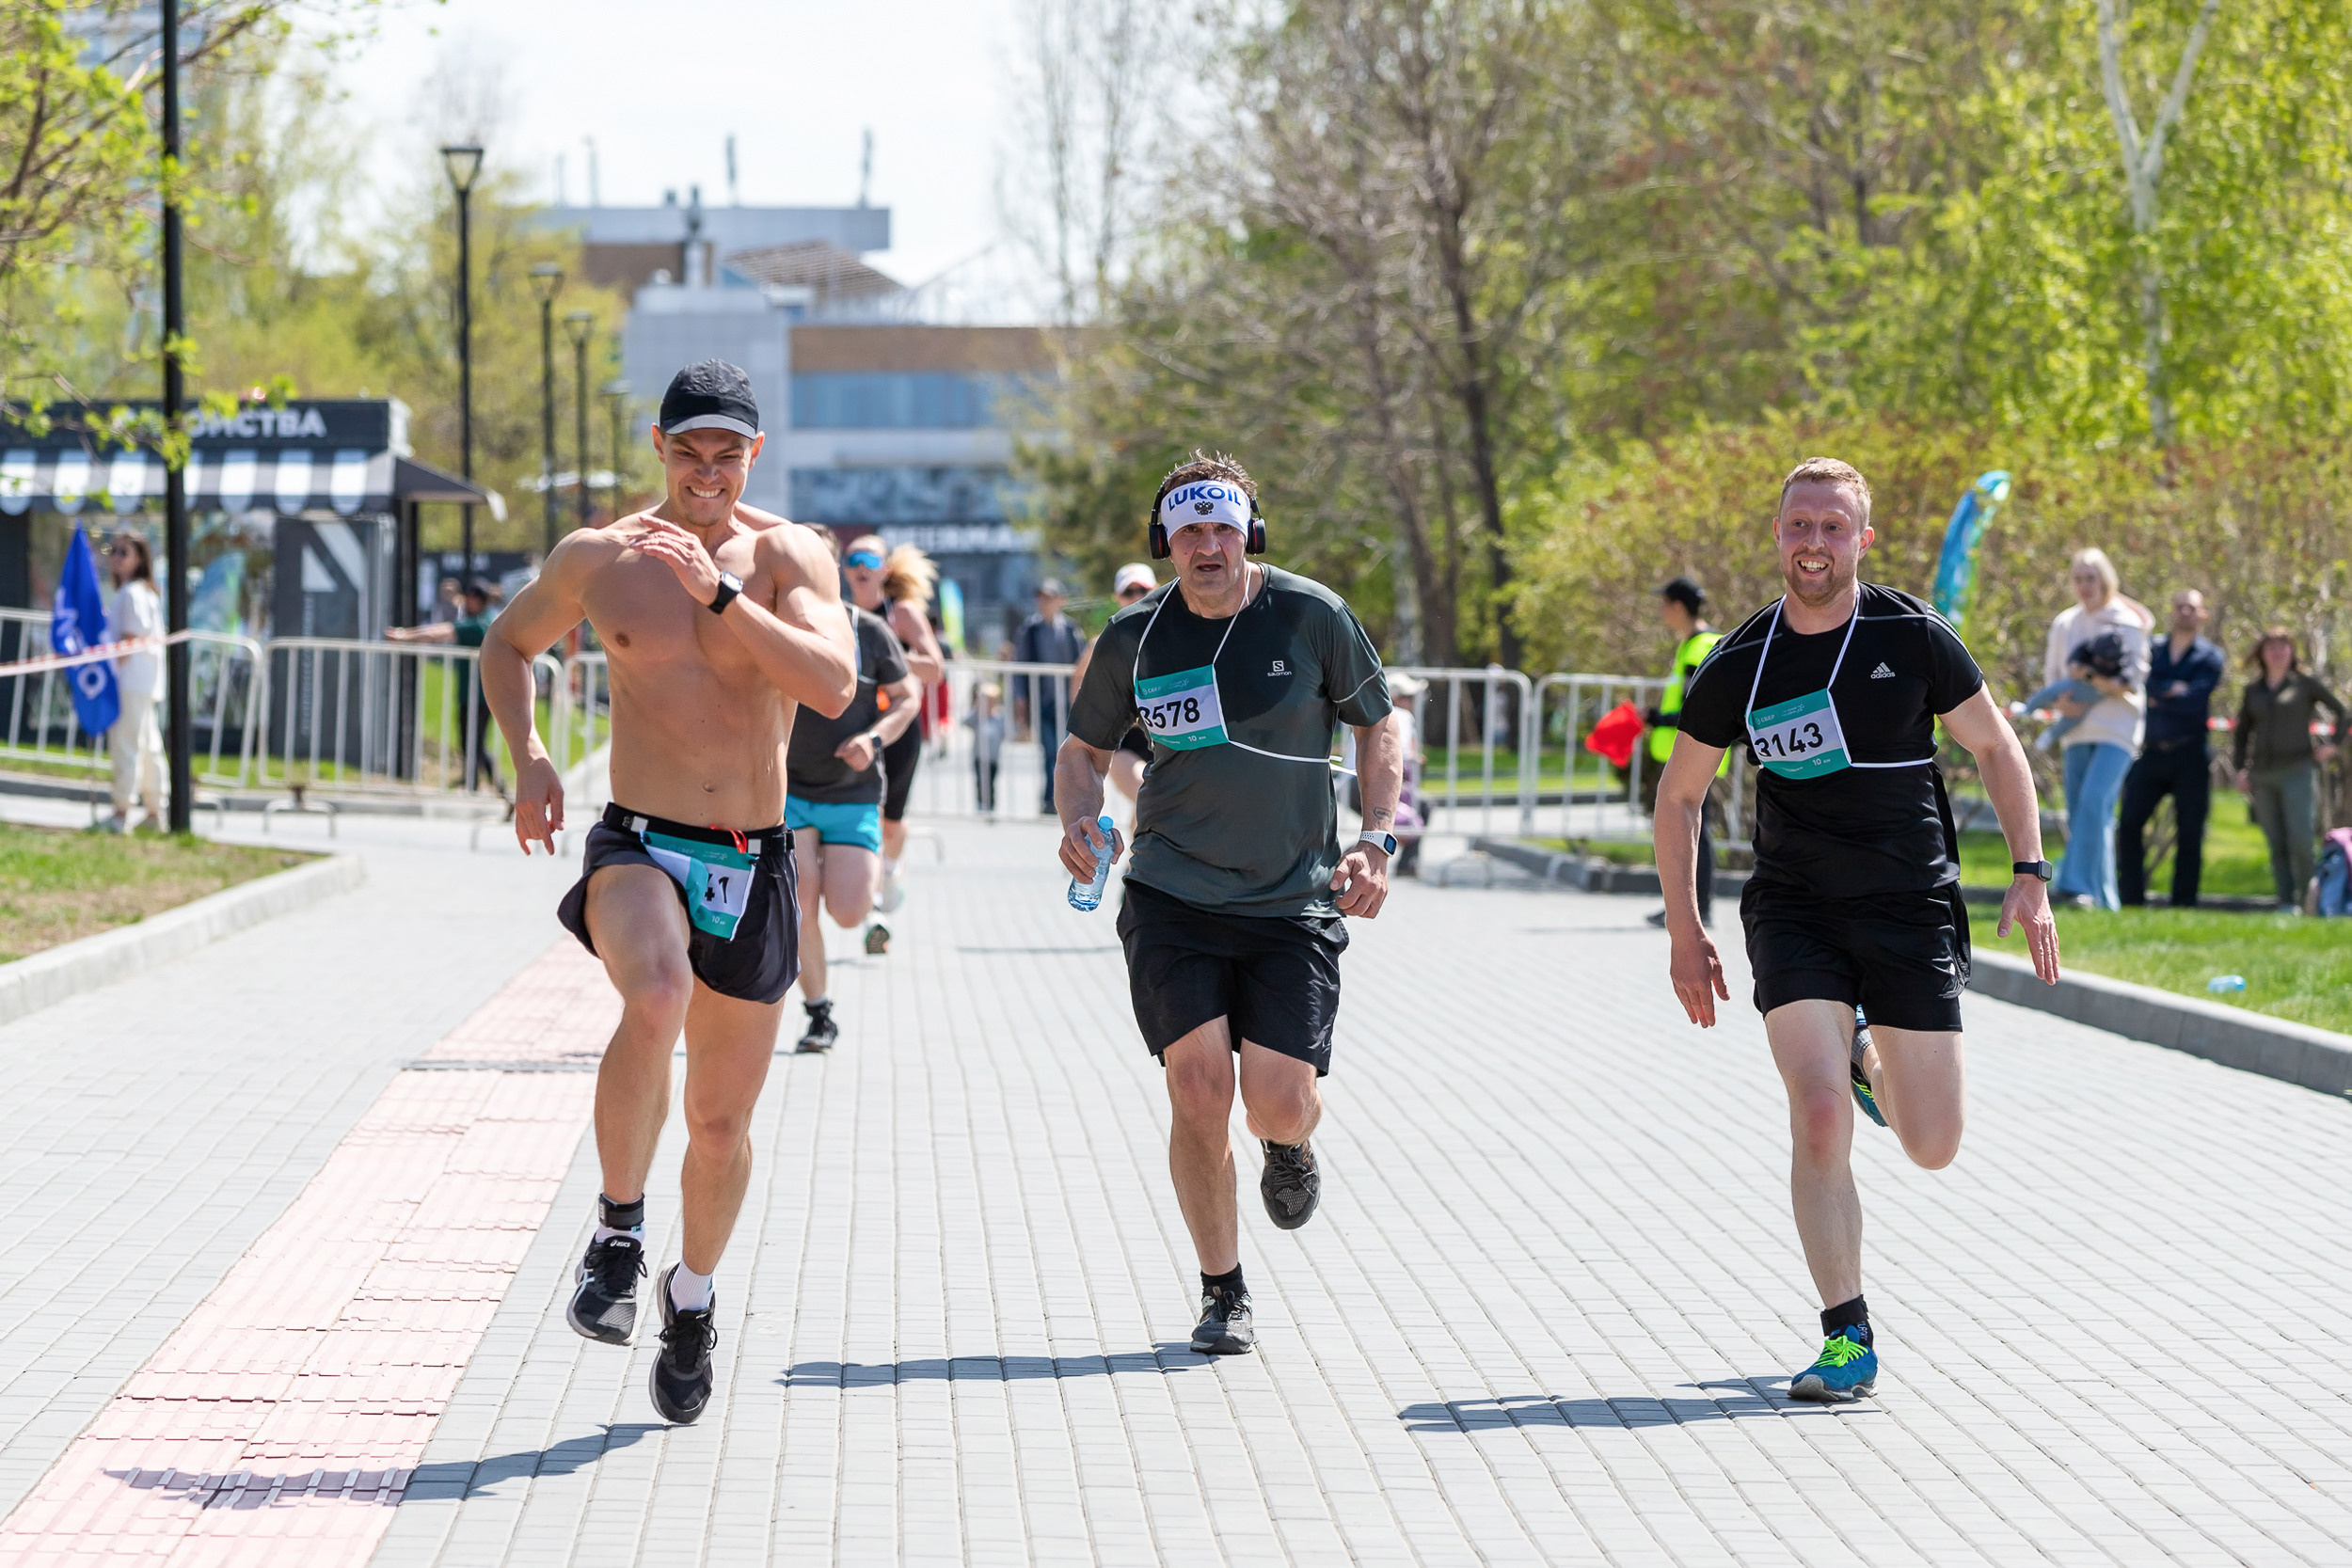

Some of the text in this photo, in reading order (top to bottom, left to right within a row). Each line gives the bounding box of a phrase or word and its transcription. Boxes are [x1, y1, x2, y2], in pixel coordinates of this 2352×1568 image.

[1168, 486, 1241, 512] LUKOIL
[1137, 697, 1200, 730] 3578
[1755, 721, 1824, 757] 3143
[1812, 758, 1822, 767] 10
[705, 872, 730, 904] 41
[711, 914, 720, 924] 10
